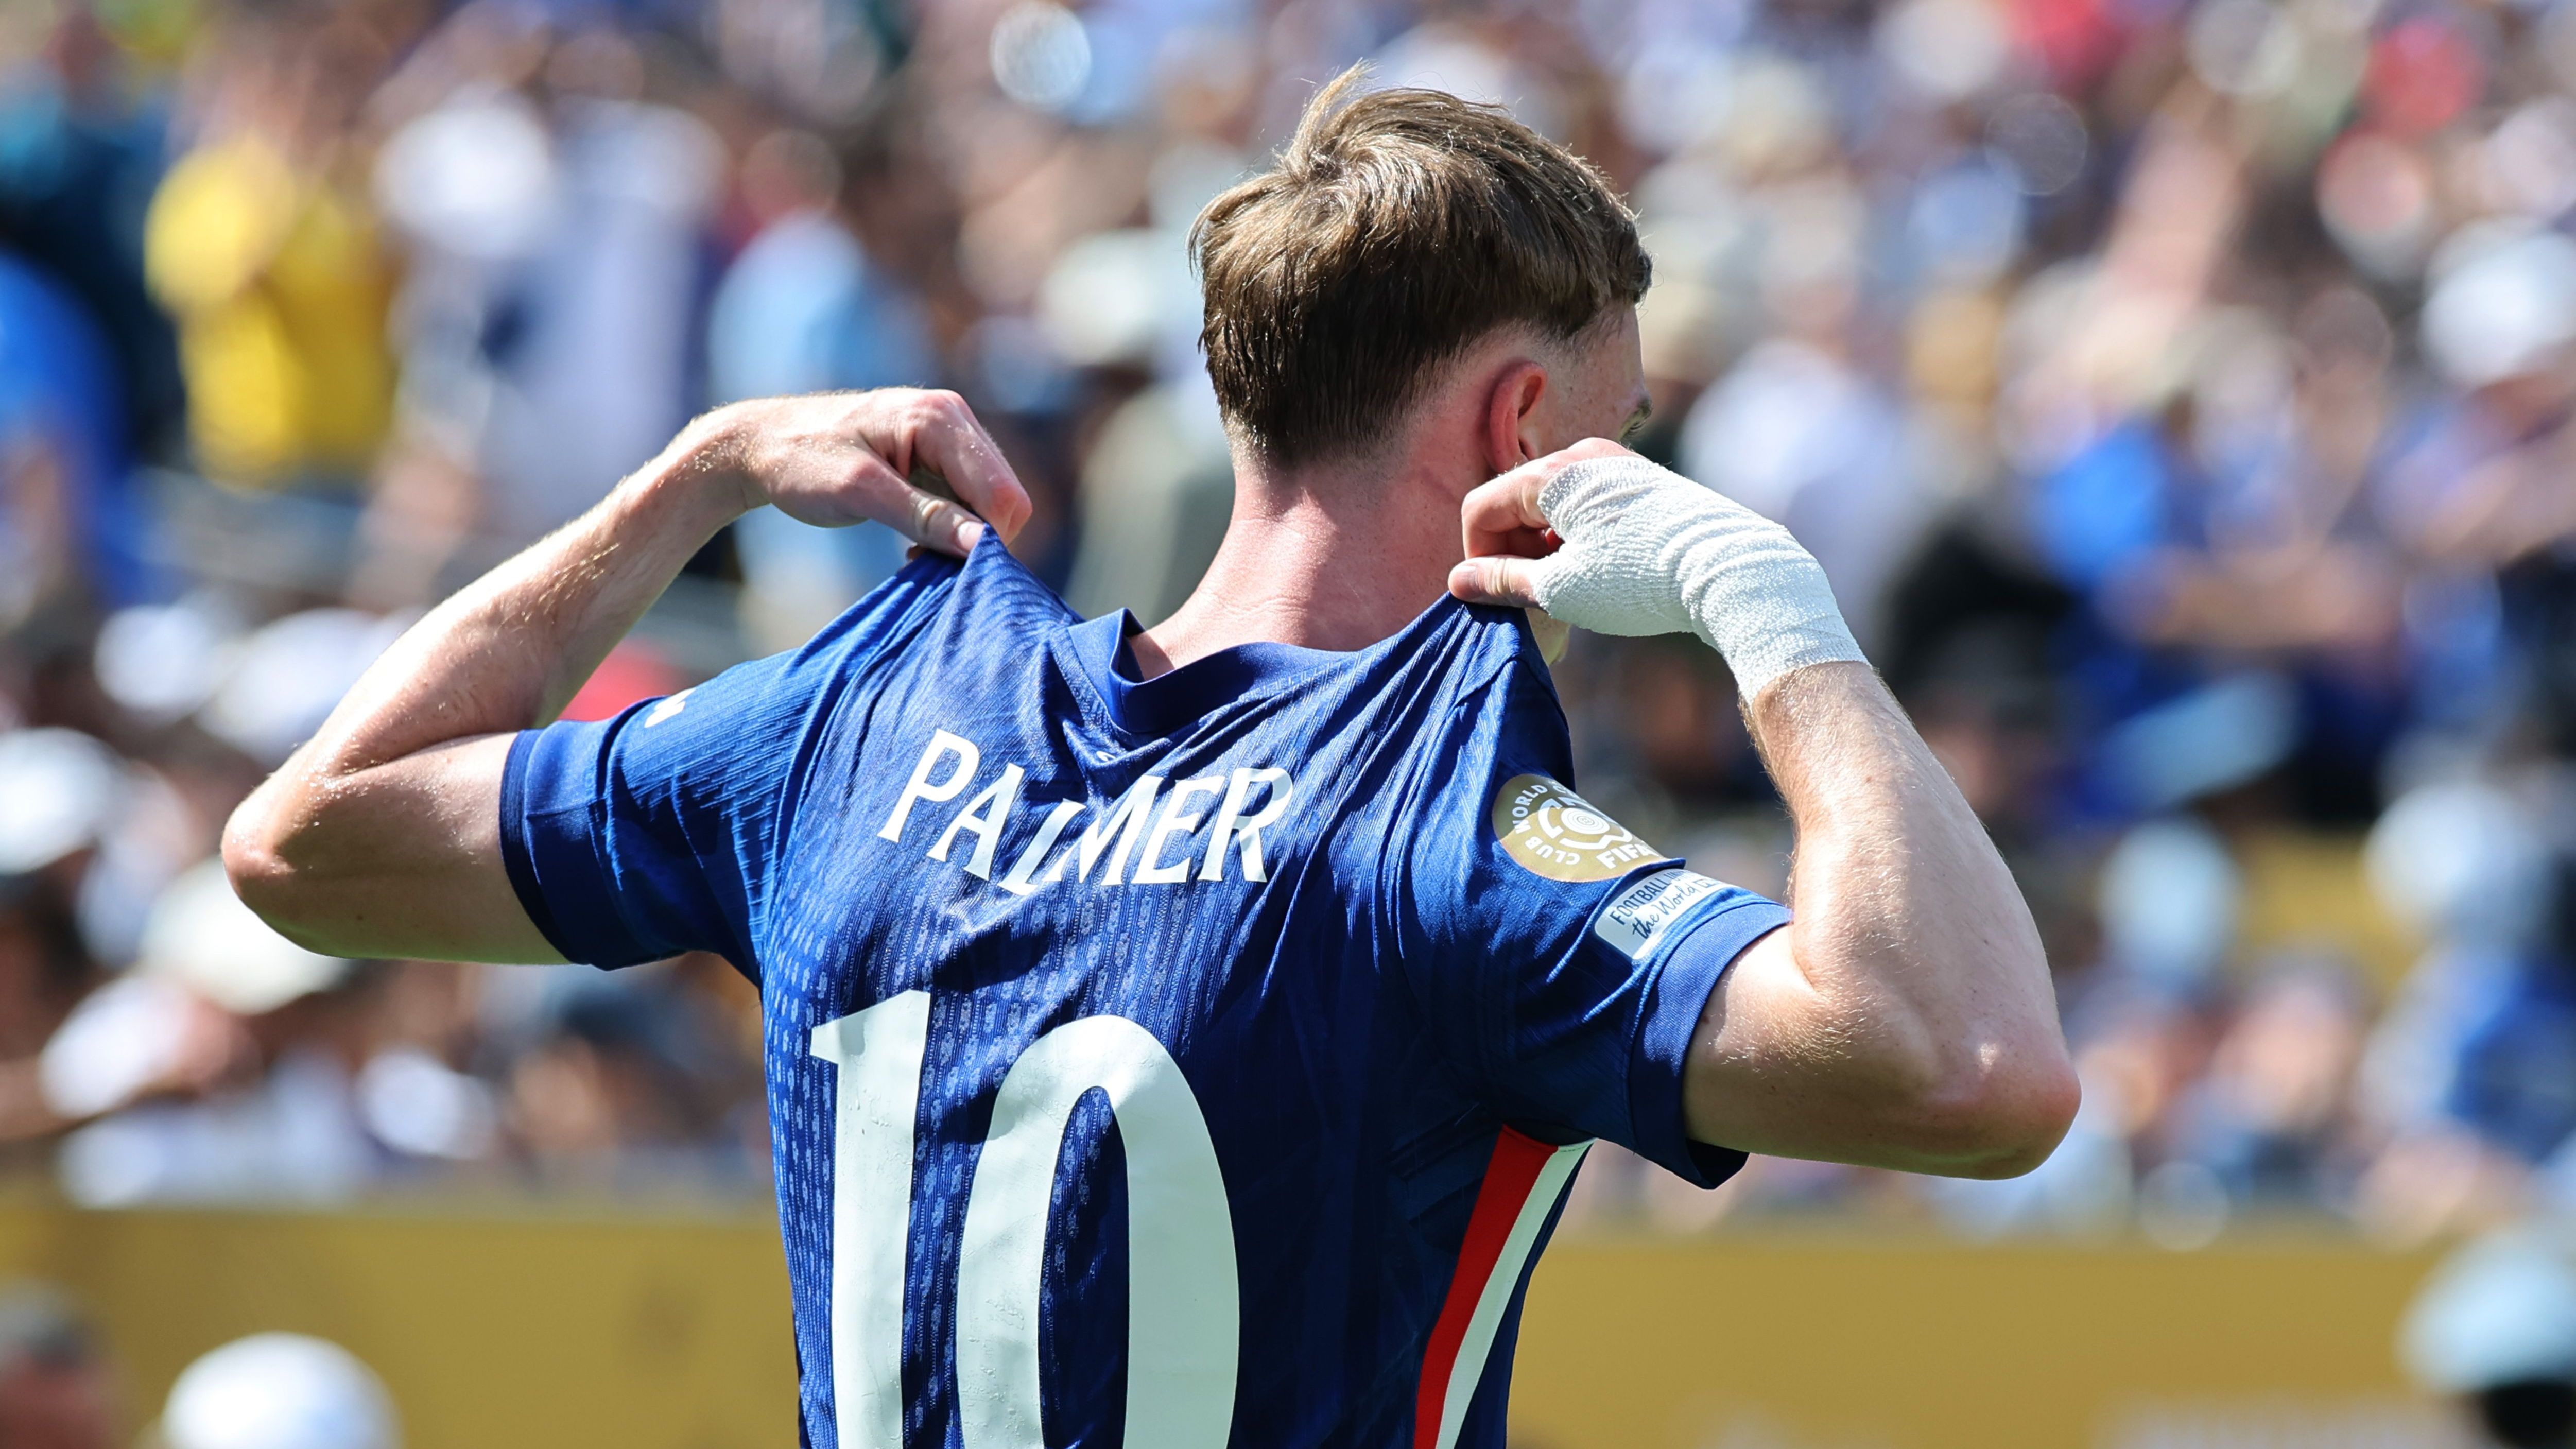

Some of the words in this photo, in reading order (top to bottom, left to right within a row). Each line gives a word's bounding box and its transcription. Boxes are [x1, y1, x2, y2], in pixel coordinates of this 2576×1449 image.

[877, 728, 1293, 896] PALMER
[1512, 785, 1548, 834] WORLD
[1525, 836, 1581, 865] CLUB
[1596, 843, 1659, 869] FIFA
[1610, 877, 1672, 925] FOOTBALL
[1632, 913, 1660, 940] the
[1651, 882, 1702, 916] World
[810, 989, 1240, 1449] 10
